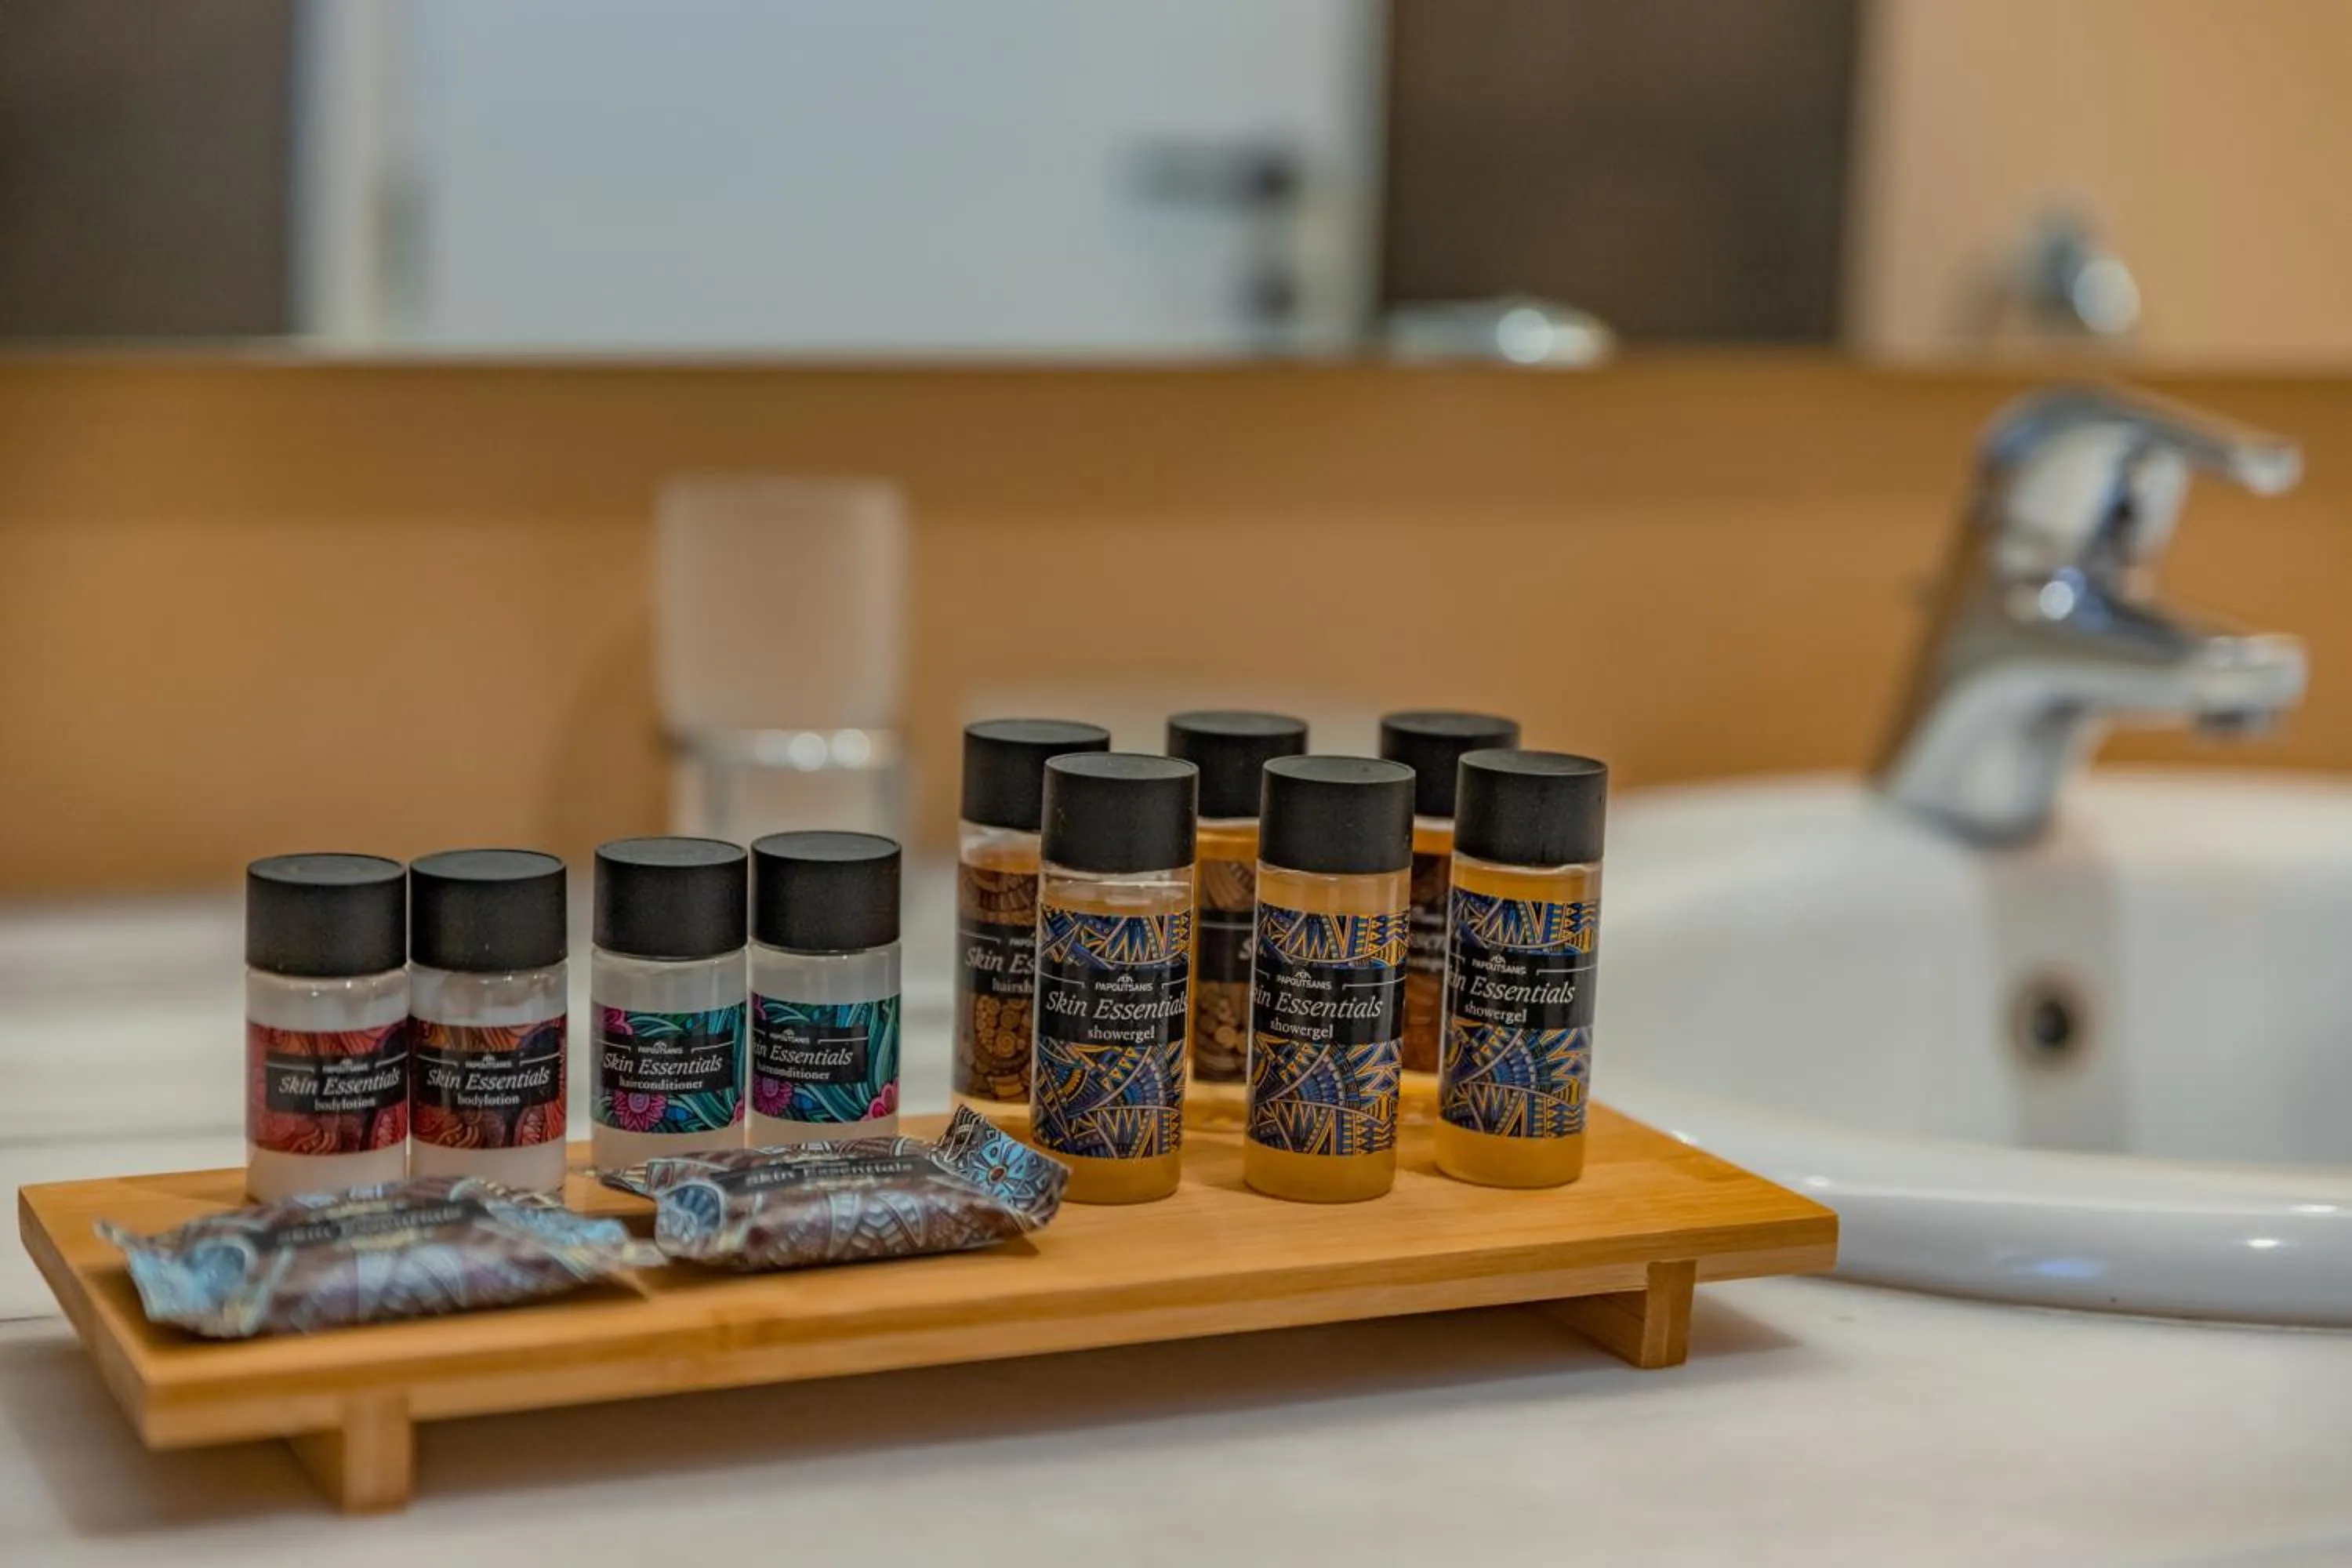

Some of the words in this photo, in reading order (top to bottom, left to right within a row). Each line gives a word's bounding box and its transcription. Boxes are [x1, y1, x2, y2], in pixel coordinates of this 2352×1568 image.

[964, 946, 1004, 971] Skin
[1472, 957, 1527, 975] PAPOUTSANIS
[992, 977, 1035, 993] hairsh
[1094, 982, 1154, 992] PAPOUTSANIS
[1276, 974, 1332, 990] PAPOUTSANIS
[1469, 975, 1576, 1004] Essentials
[1046, 990, 1088, 1018] Skin
[1092, 990, 1189, 1021] Essentials
[1254, 985, 1272, 1008] in
[1274, 990, 1385, 1019] Essentials
[1465, 1000, 1528, 1024] showergel
[1087, 1024, 1155, 1044] showergel
[1269, 1016, 1334, 1040] showergel
[603, 1053, 633, 1073] Skin
[637, 1054, 723, 1075] Essentials
[769, 1044, 854, 1065] Essentials
[278, 1075, 319, 1096] Skin
[322, 1067, 401, 1095] Essentials
[426, 1069, 461, 1090] Skin
[465, 1065, 551, 1091] Essentials
[619, 1075, 703, 1091] hairconditioner
[314, 1098, 376, 1112] bodylotion
[457, 1093, 521, 1109] bodylotion
